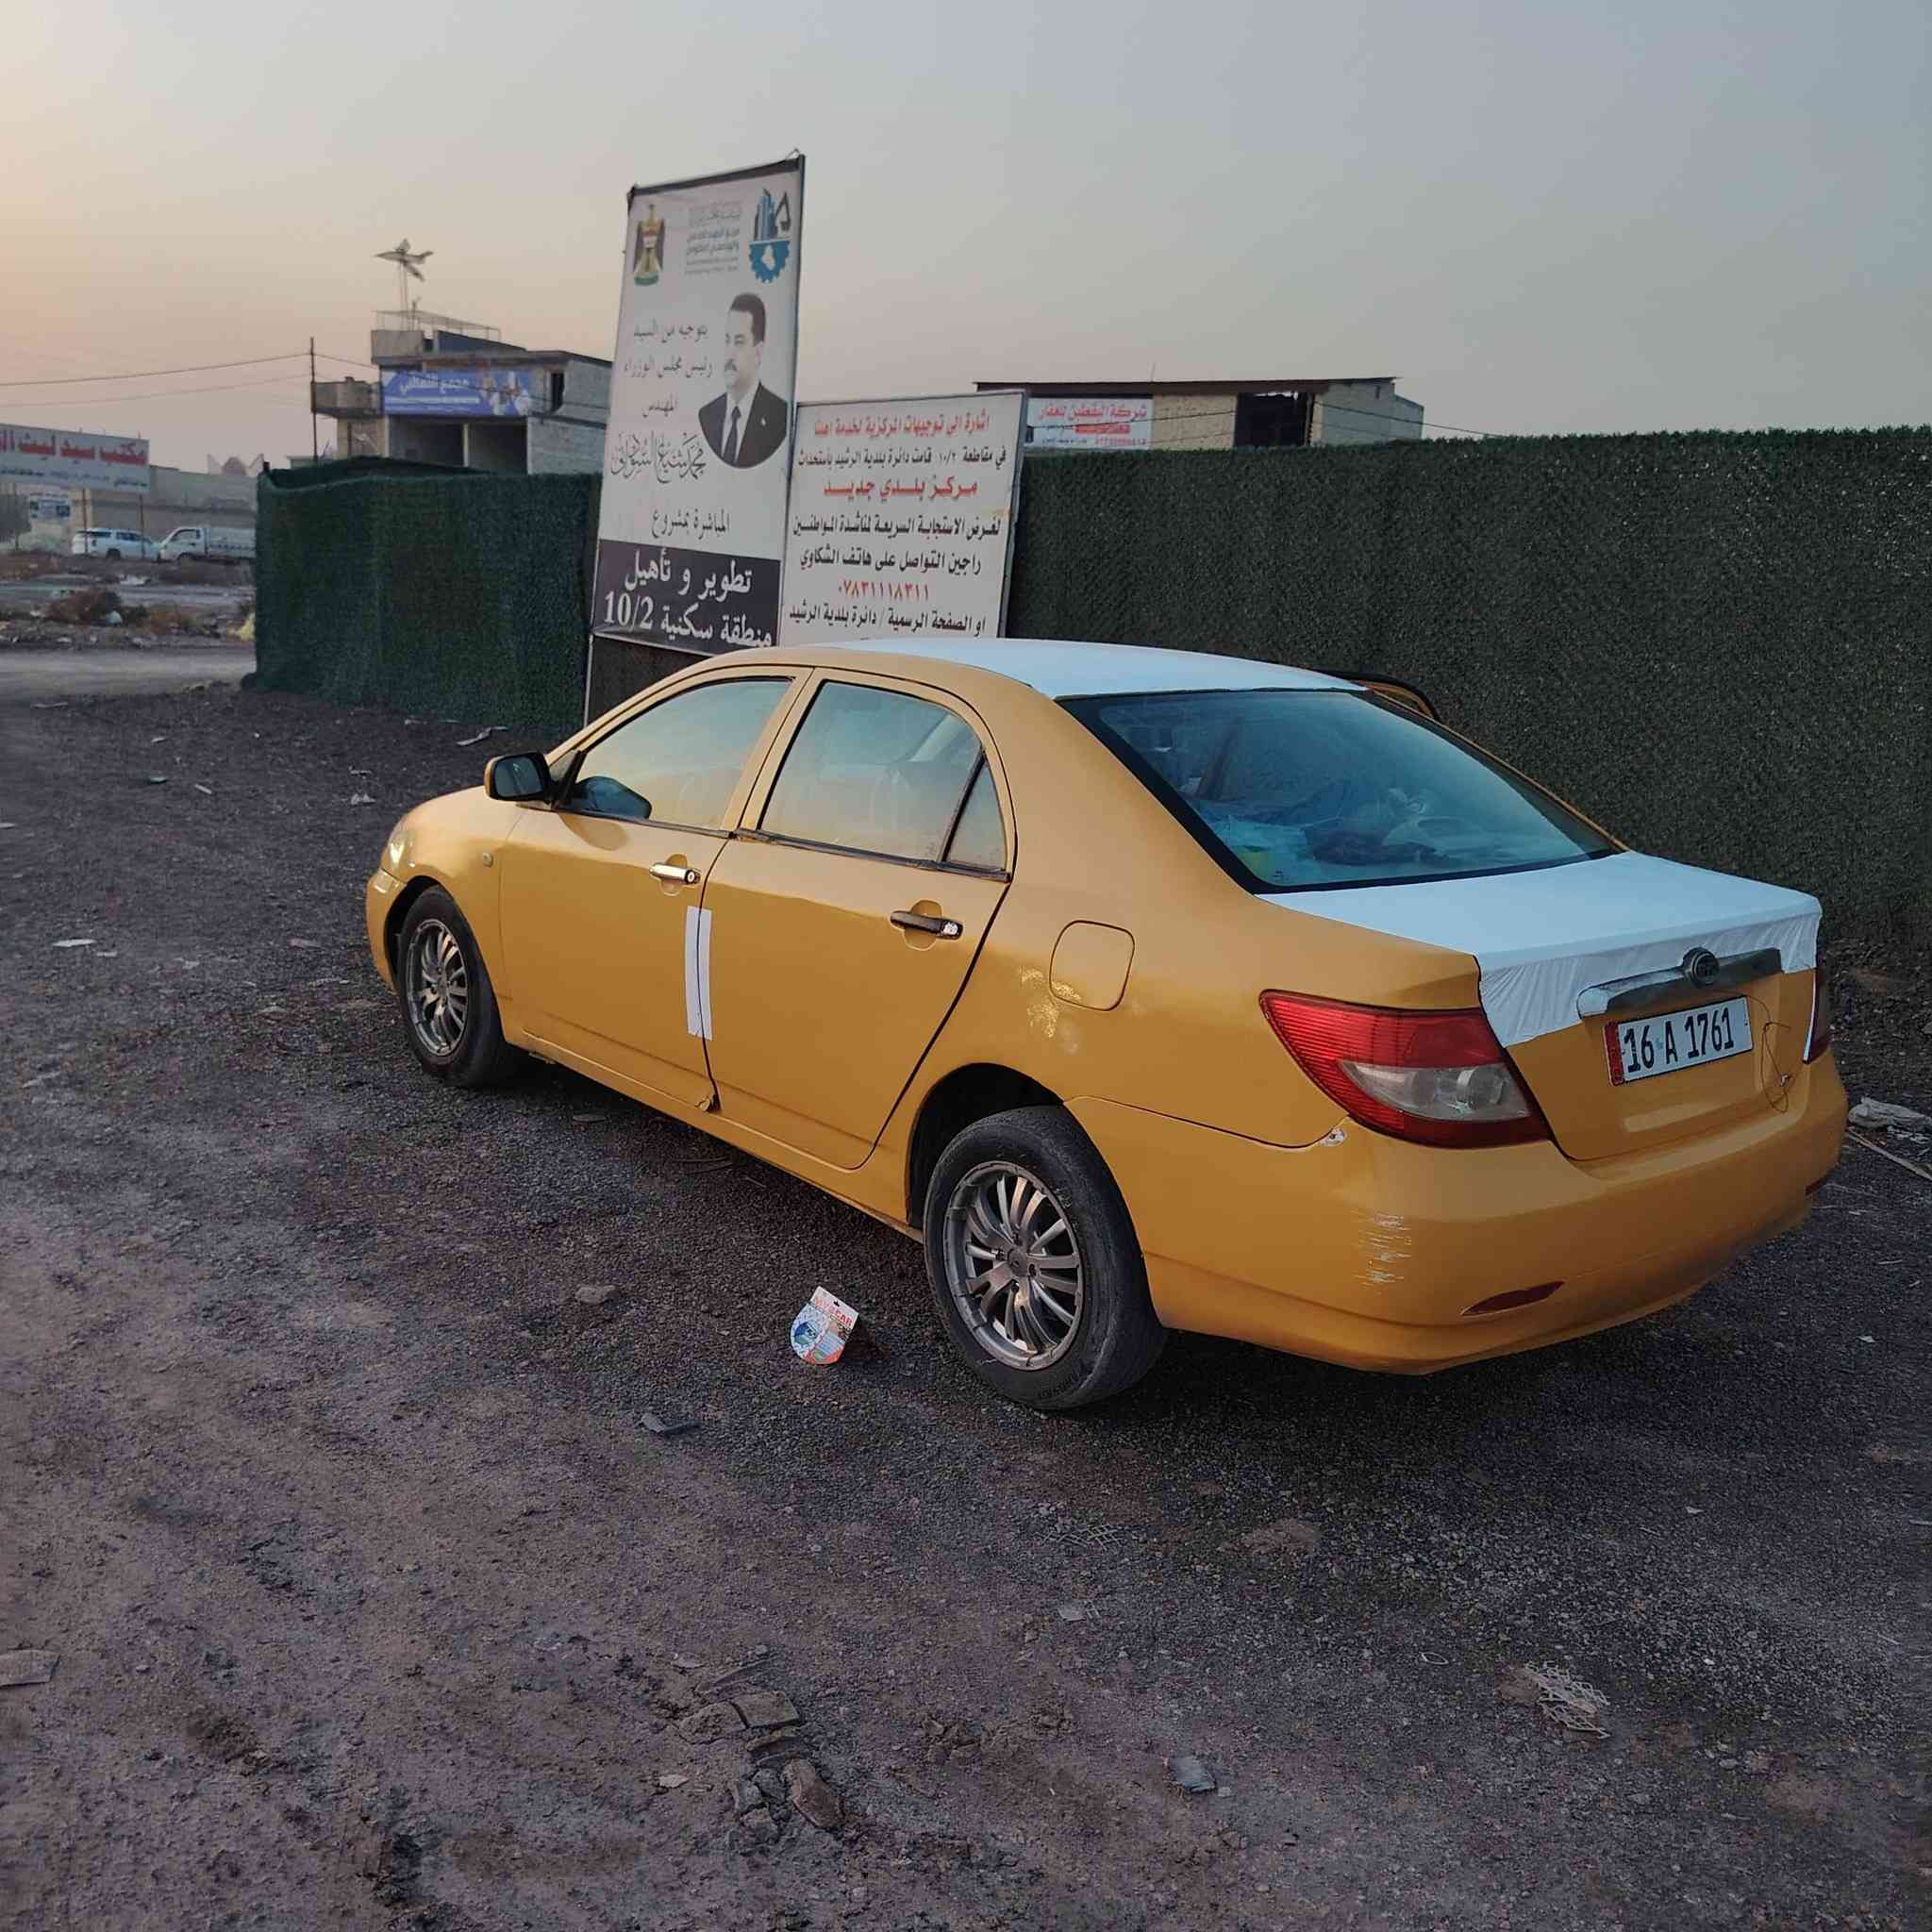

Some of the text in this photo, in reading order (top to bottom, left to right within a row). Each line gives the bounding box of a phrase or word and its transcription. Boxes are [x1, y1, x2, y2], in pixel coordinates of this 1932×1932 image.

[660, 324, 675, 344] من
[657, 355, 681, 378] مجلس
[686, 356, 713, 378] رئيس
[863, 448, 886, 469] بلدية
[911, 446, 932, 463] قامت
[963, 445, 992, 463] مقاطعة
[995, 445, 1007, 471] في
[823, 475, 977, 504] مركز بلدي جديد
[694, 508, 730, 541] المباشرة
[874, 513, 915, 540] السريعة
[918, 514, 965, 541] الاستجابة
[966, 515, 1001, 541] لغرض
[842, 546, 872, 566] هاتف
[874, 550, 896, 572] على
[899, 549, 945, 574] التواصل
[948, 552, 982, 576] راجين
[625, 547, 752, 602] تطوير و تأهيل
[604, 591, 773, 648] منطقة سكنية 10/2
[790, 598, 821, 624] الرشيد
[824, 603, 849, 628] بلدية
[888, 608, 929, 633] الرسمية
[931, 610, 973, 631] الصفحة
[1624, 1024, 1655, 1074] 16
[1665, 1020, 1679, 1065] A
[1684, 1007, 1735, 1059] 1761
